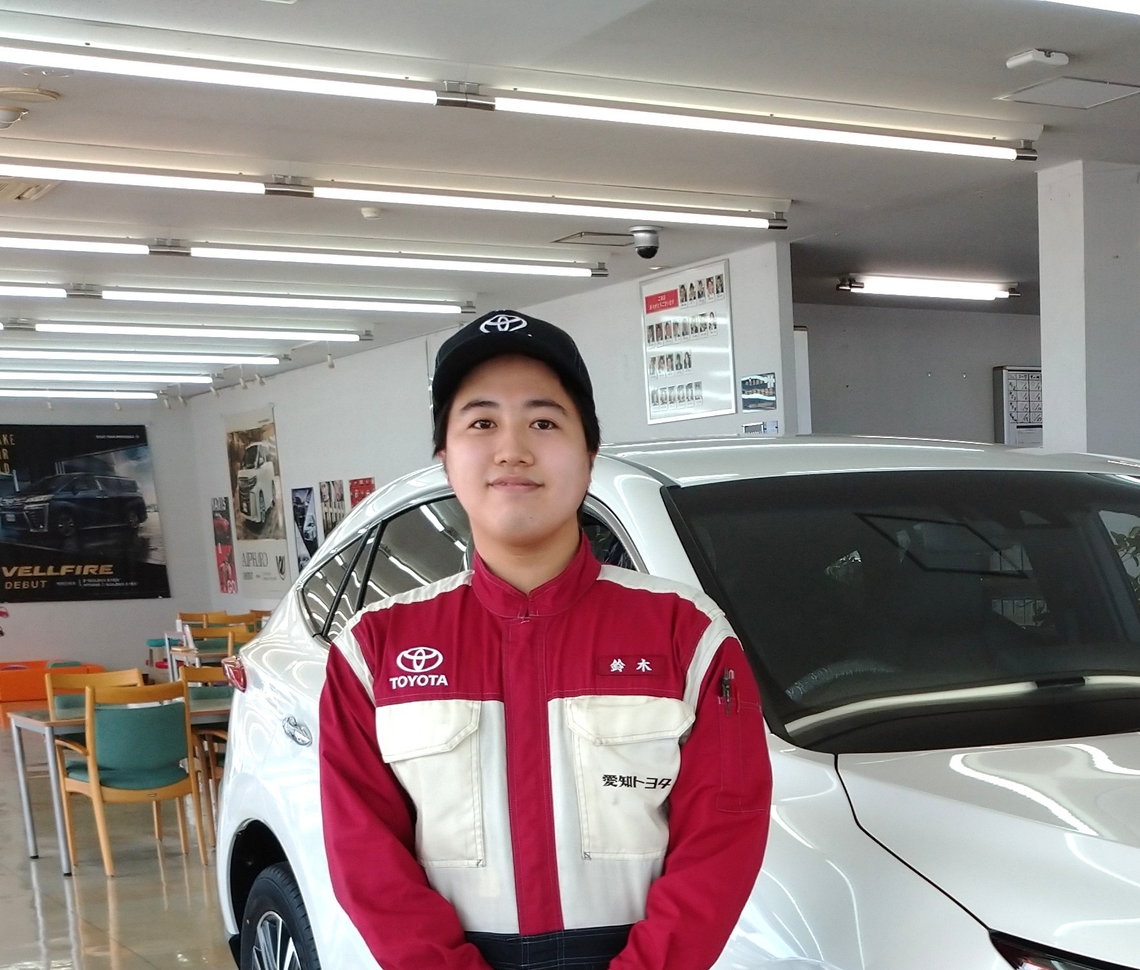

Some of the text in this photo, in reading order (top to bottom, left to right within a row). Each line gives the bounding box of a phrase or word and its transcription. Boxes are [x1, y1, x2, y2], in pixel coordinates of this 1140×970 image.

[1, 564, 114, 577] VELLFIRE
[4, 580, 47, 590] DEBUT
[610, 658, 652, 673] 鈴木
[389, 674, 448, 689] TOYOTA
[602, 774, 673, 790] 愛知トヨタ
